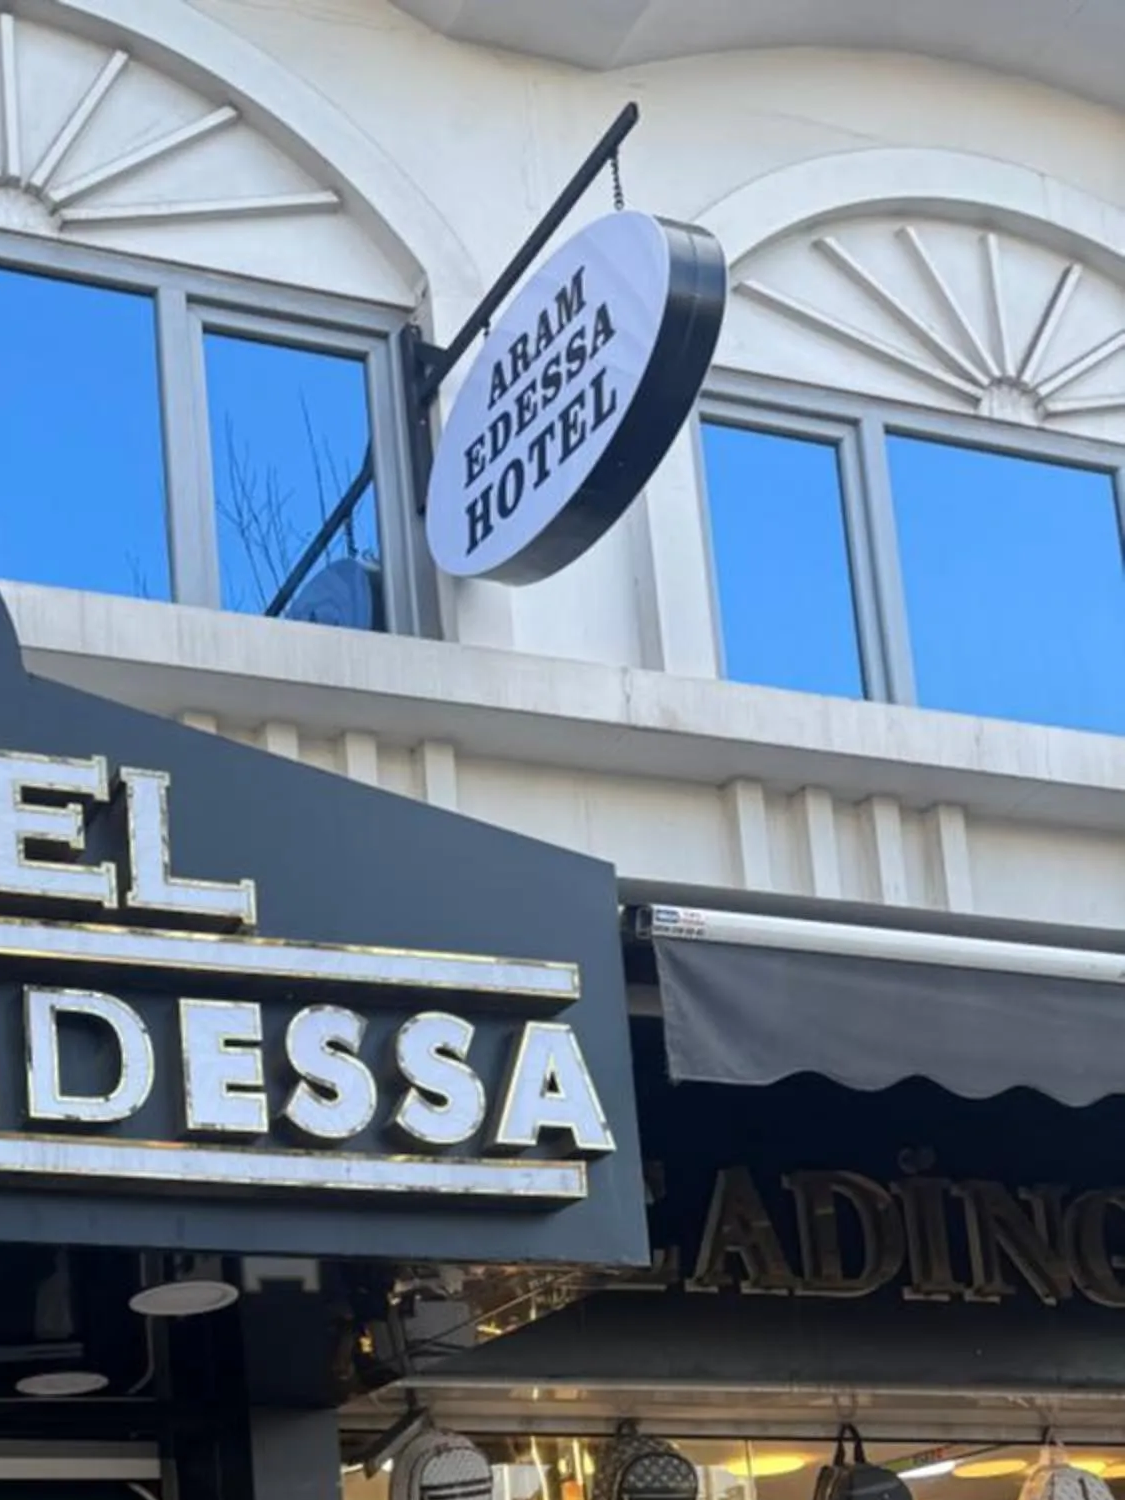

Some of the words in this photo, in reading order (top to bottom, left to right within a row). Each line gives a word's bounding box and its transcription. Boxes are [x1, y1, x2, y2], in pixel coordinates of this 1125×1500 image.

[463, 303, 616, 488] EDESSA
[488, 265, 586, 410] ARAM
[465, 367, 617, 557] HOTEL
